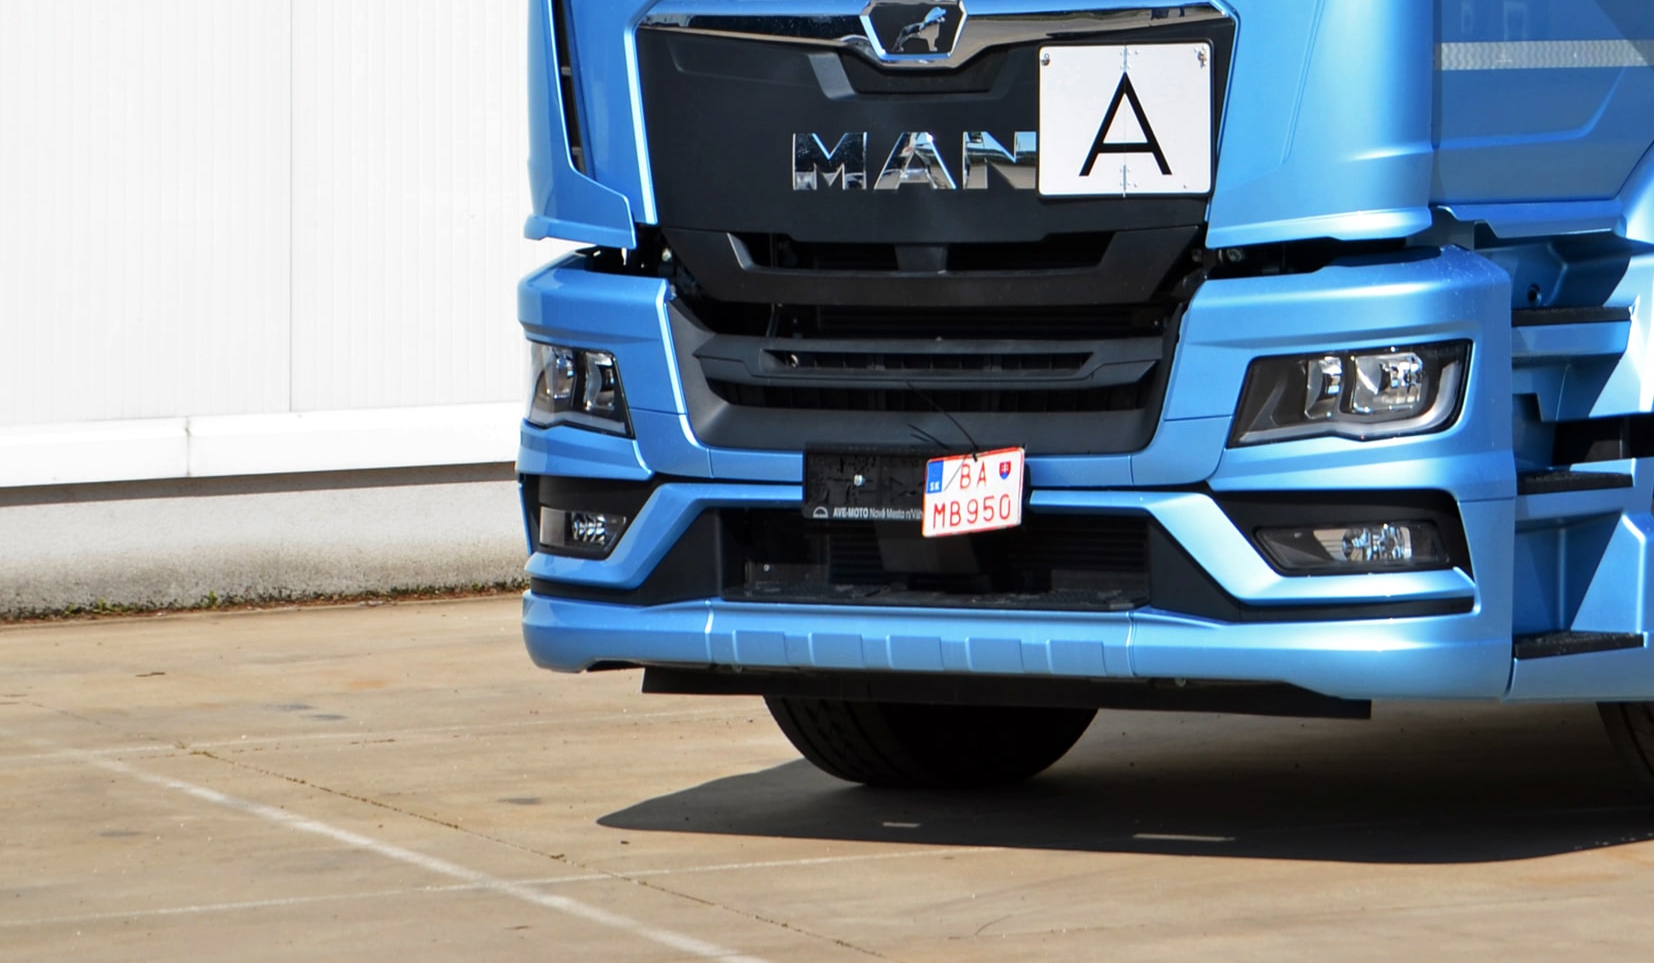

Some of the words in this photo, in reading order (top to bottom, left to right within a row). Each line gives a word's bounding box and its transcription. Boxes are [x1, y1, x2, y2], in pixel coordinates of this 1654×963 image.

[1078, 71, 1173, 177] A
[792, 131, 1037, 190] MAN
[929, 481, 940, 492] SK
[960, 461, 987, 490] BA
[833, 507, 869, 518] AVE-MOTO
[933, 493, 1011, 530] MB950
